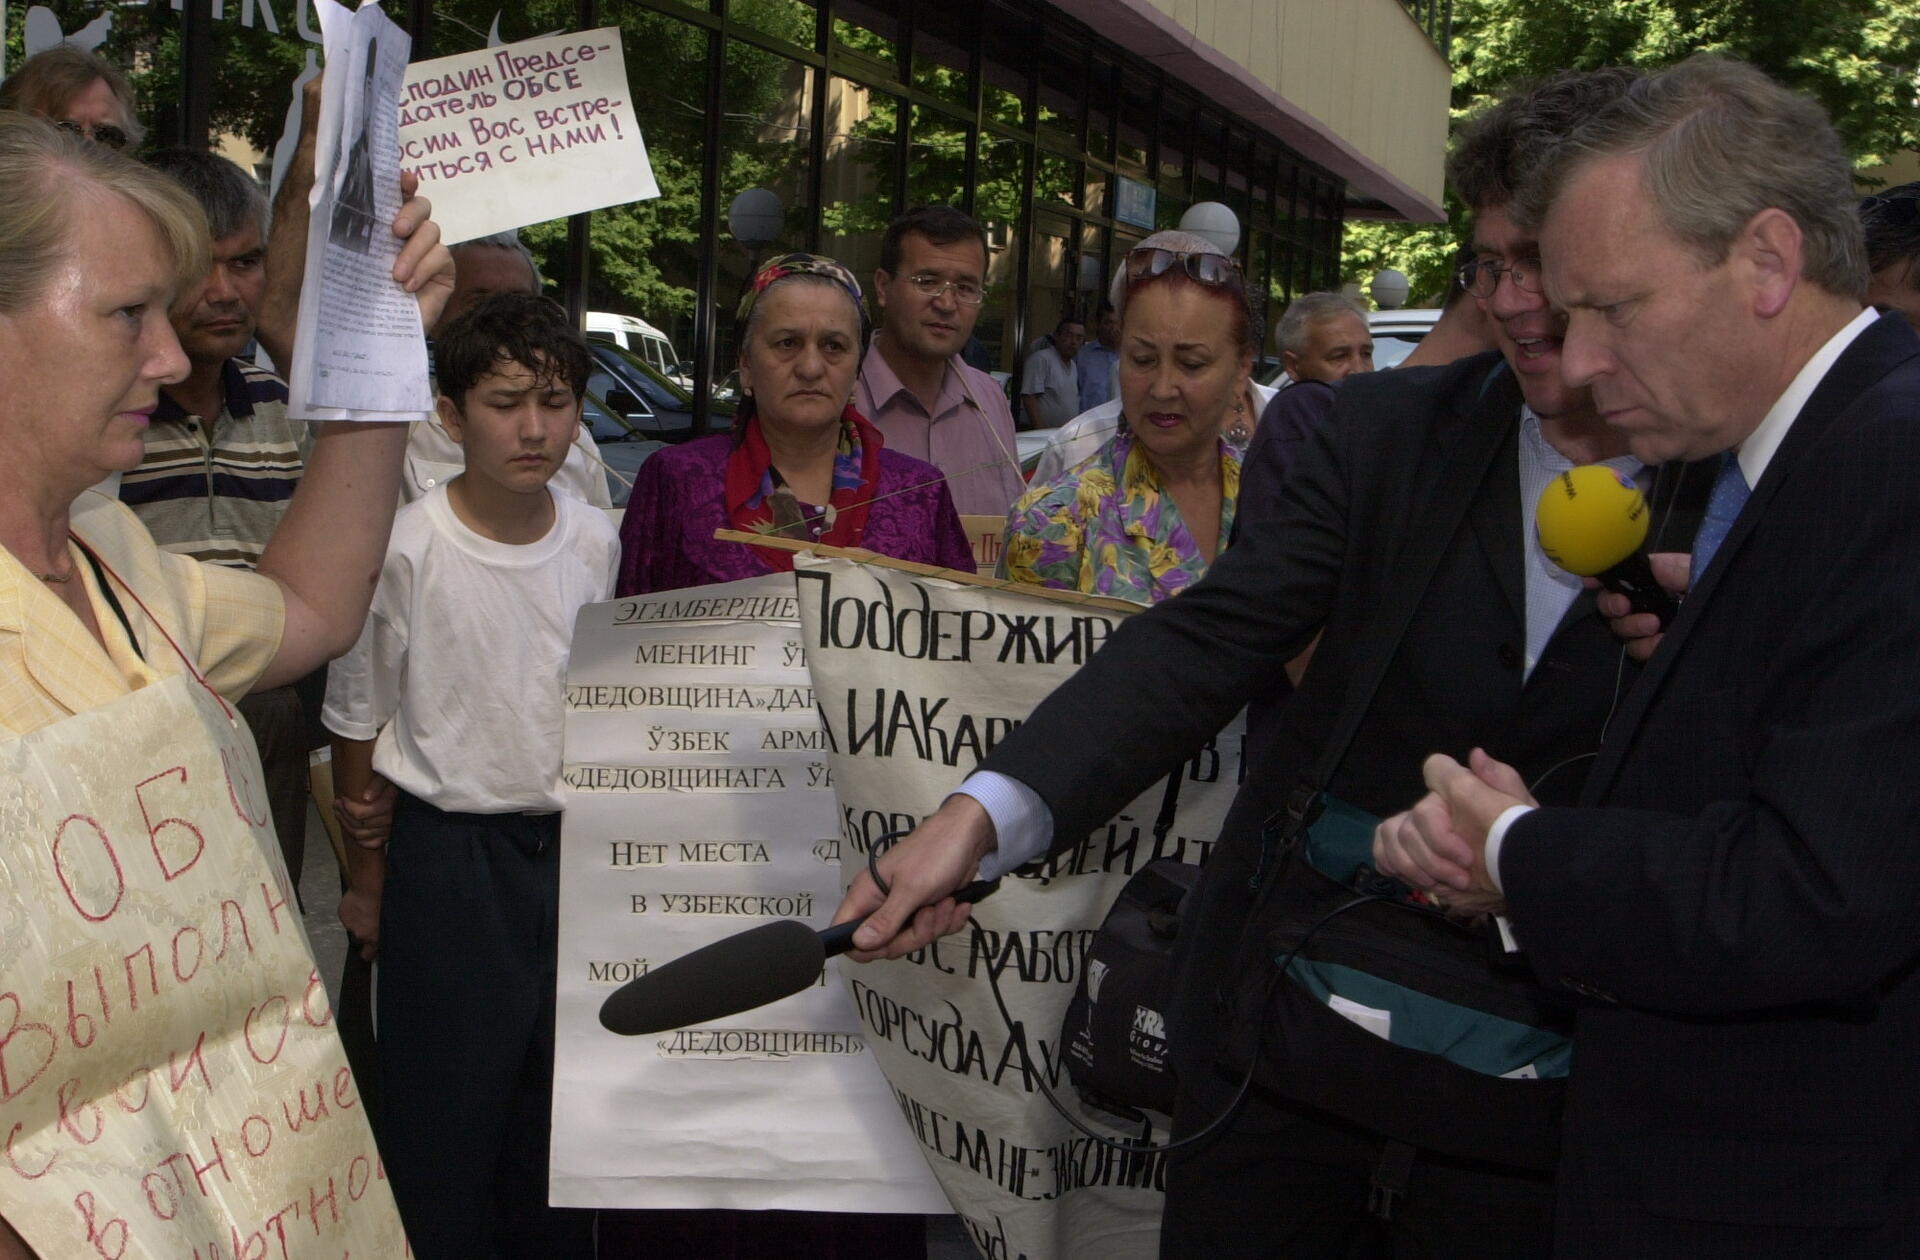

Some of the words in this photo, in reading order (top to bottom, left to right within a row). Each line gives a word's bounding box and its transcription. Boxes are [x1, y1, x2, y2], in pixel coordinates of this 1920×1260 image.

[503, 67, 583, 101] ОБСЕ
[468, 116, 525, 146] Вас
[612, 596, 799, 622] ЭГАМБЕРДИЕ
[634, 643, 756, 666] МЕНИНГ
[647, 725, 731, 751] ЎЗБЕК
[562, 766, 785, 791] «ДЕДОВЩИНАГА
[661, 892, 813, 917] УЗБЕКСКОЙ
[588, 958, 650, 982] МОЙ
[656, 1029, 866, 1058] «ДЕДОВЩИНЫ»
